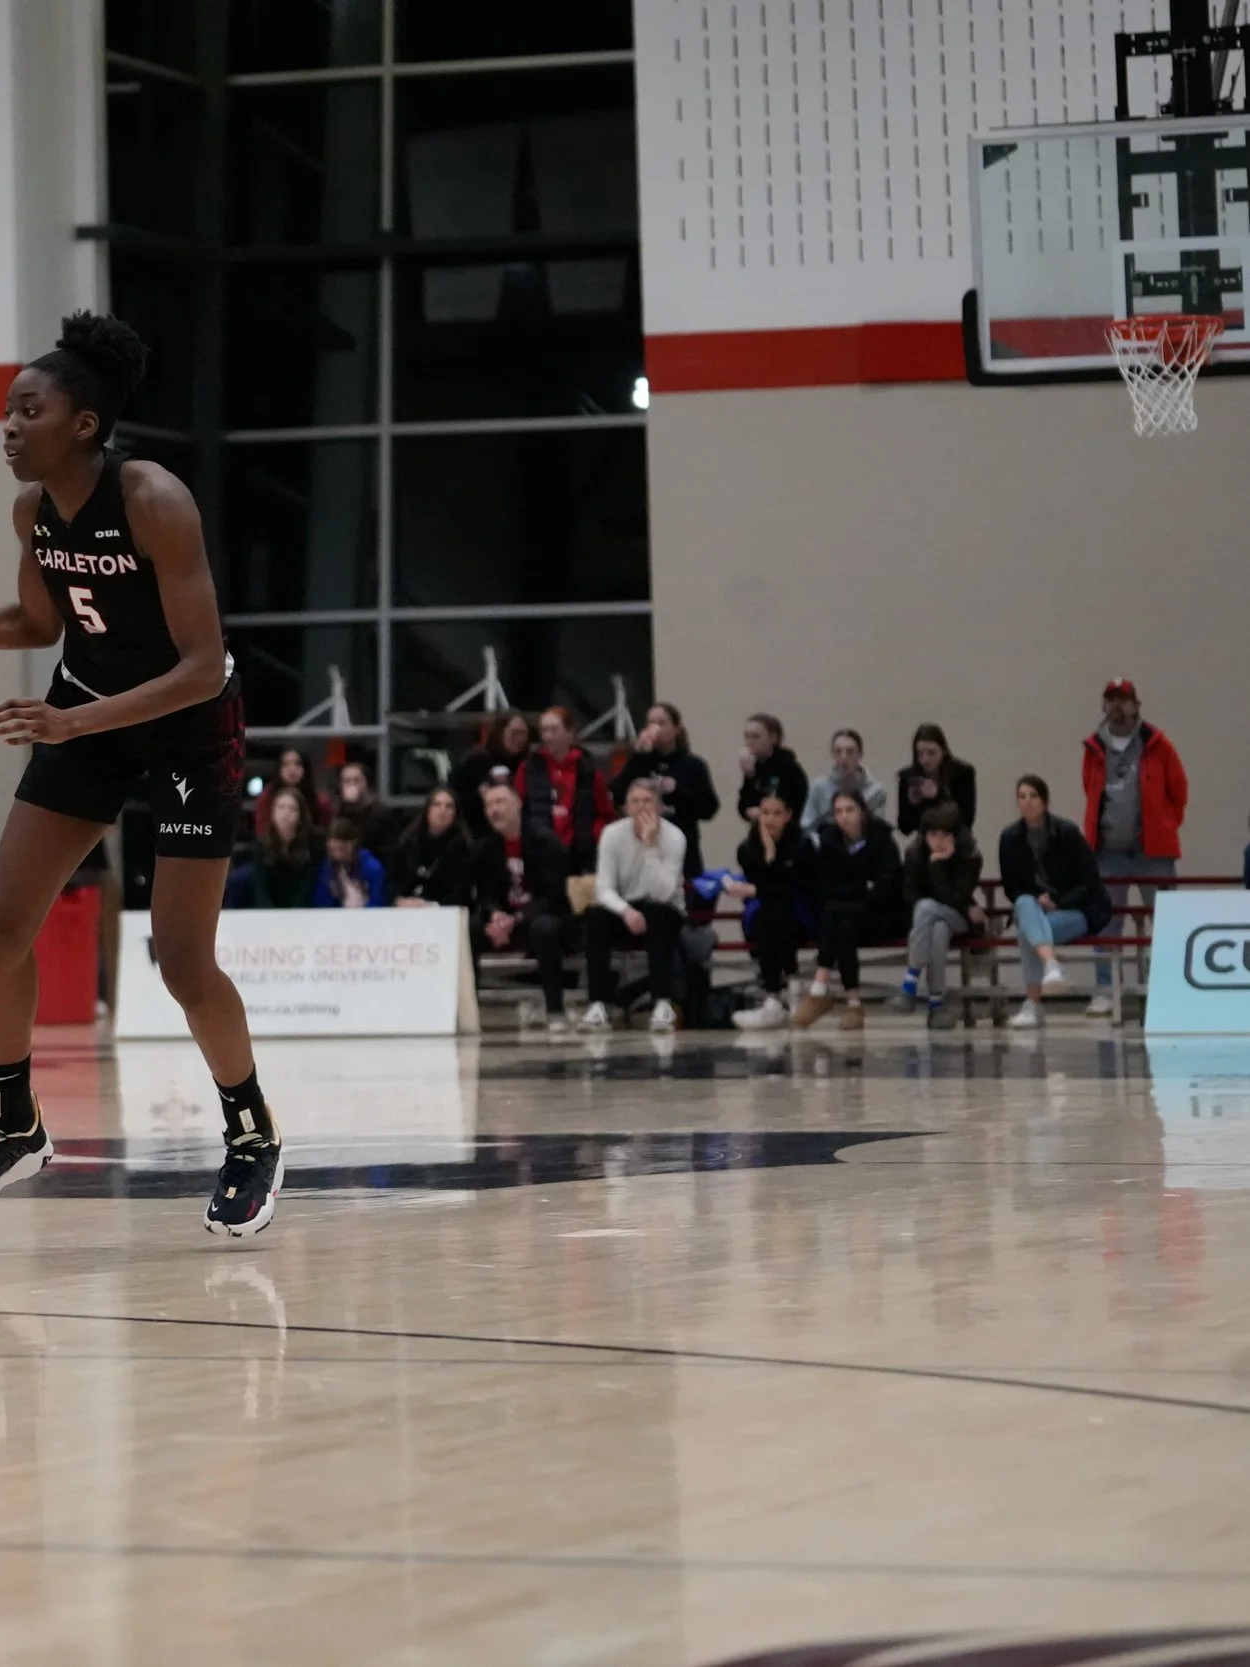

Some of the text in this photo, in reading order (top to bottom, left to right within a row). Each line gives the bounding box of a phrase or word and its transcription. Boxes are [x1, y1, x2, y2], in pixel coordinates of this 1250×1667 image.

[95, 530, 120, 538] OUA
[35, 548, 138, 576] CARLETON
[68, 586, 107, 634] 5
[159, 823, 213, 836] RAVENS
[314, 943, 440, 966] SERVICES
[1205, 940, 1250, 973] C
[230, 969, 408, 984] ARLETON UNIVERSITY
